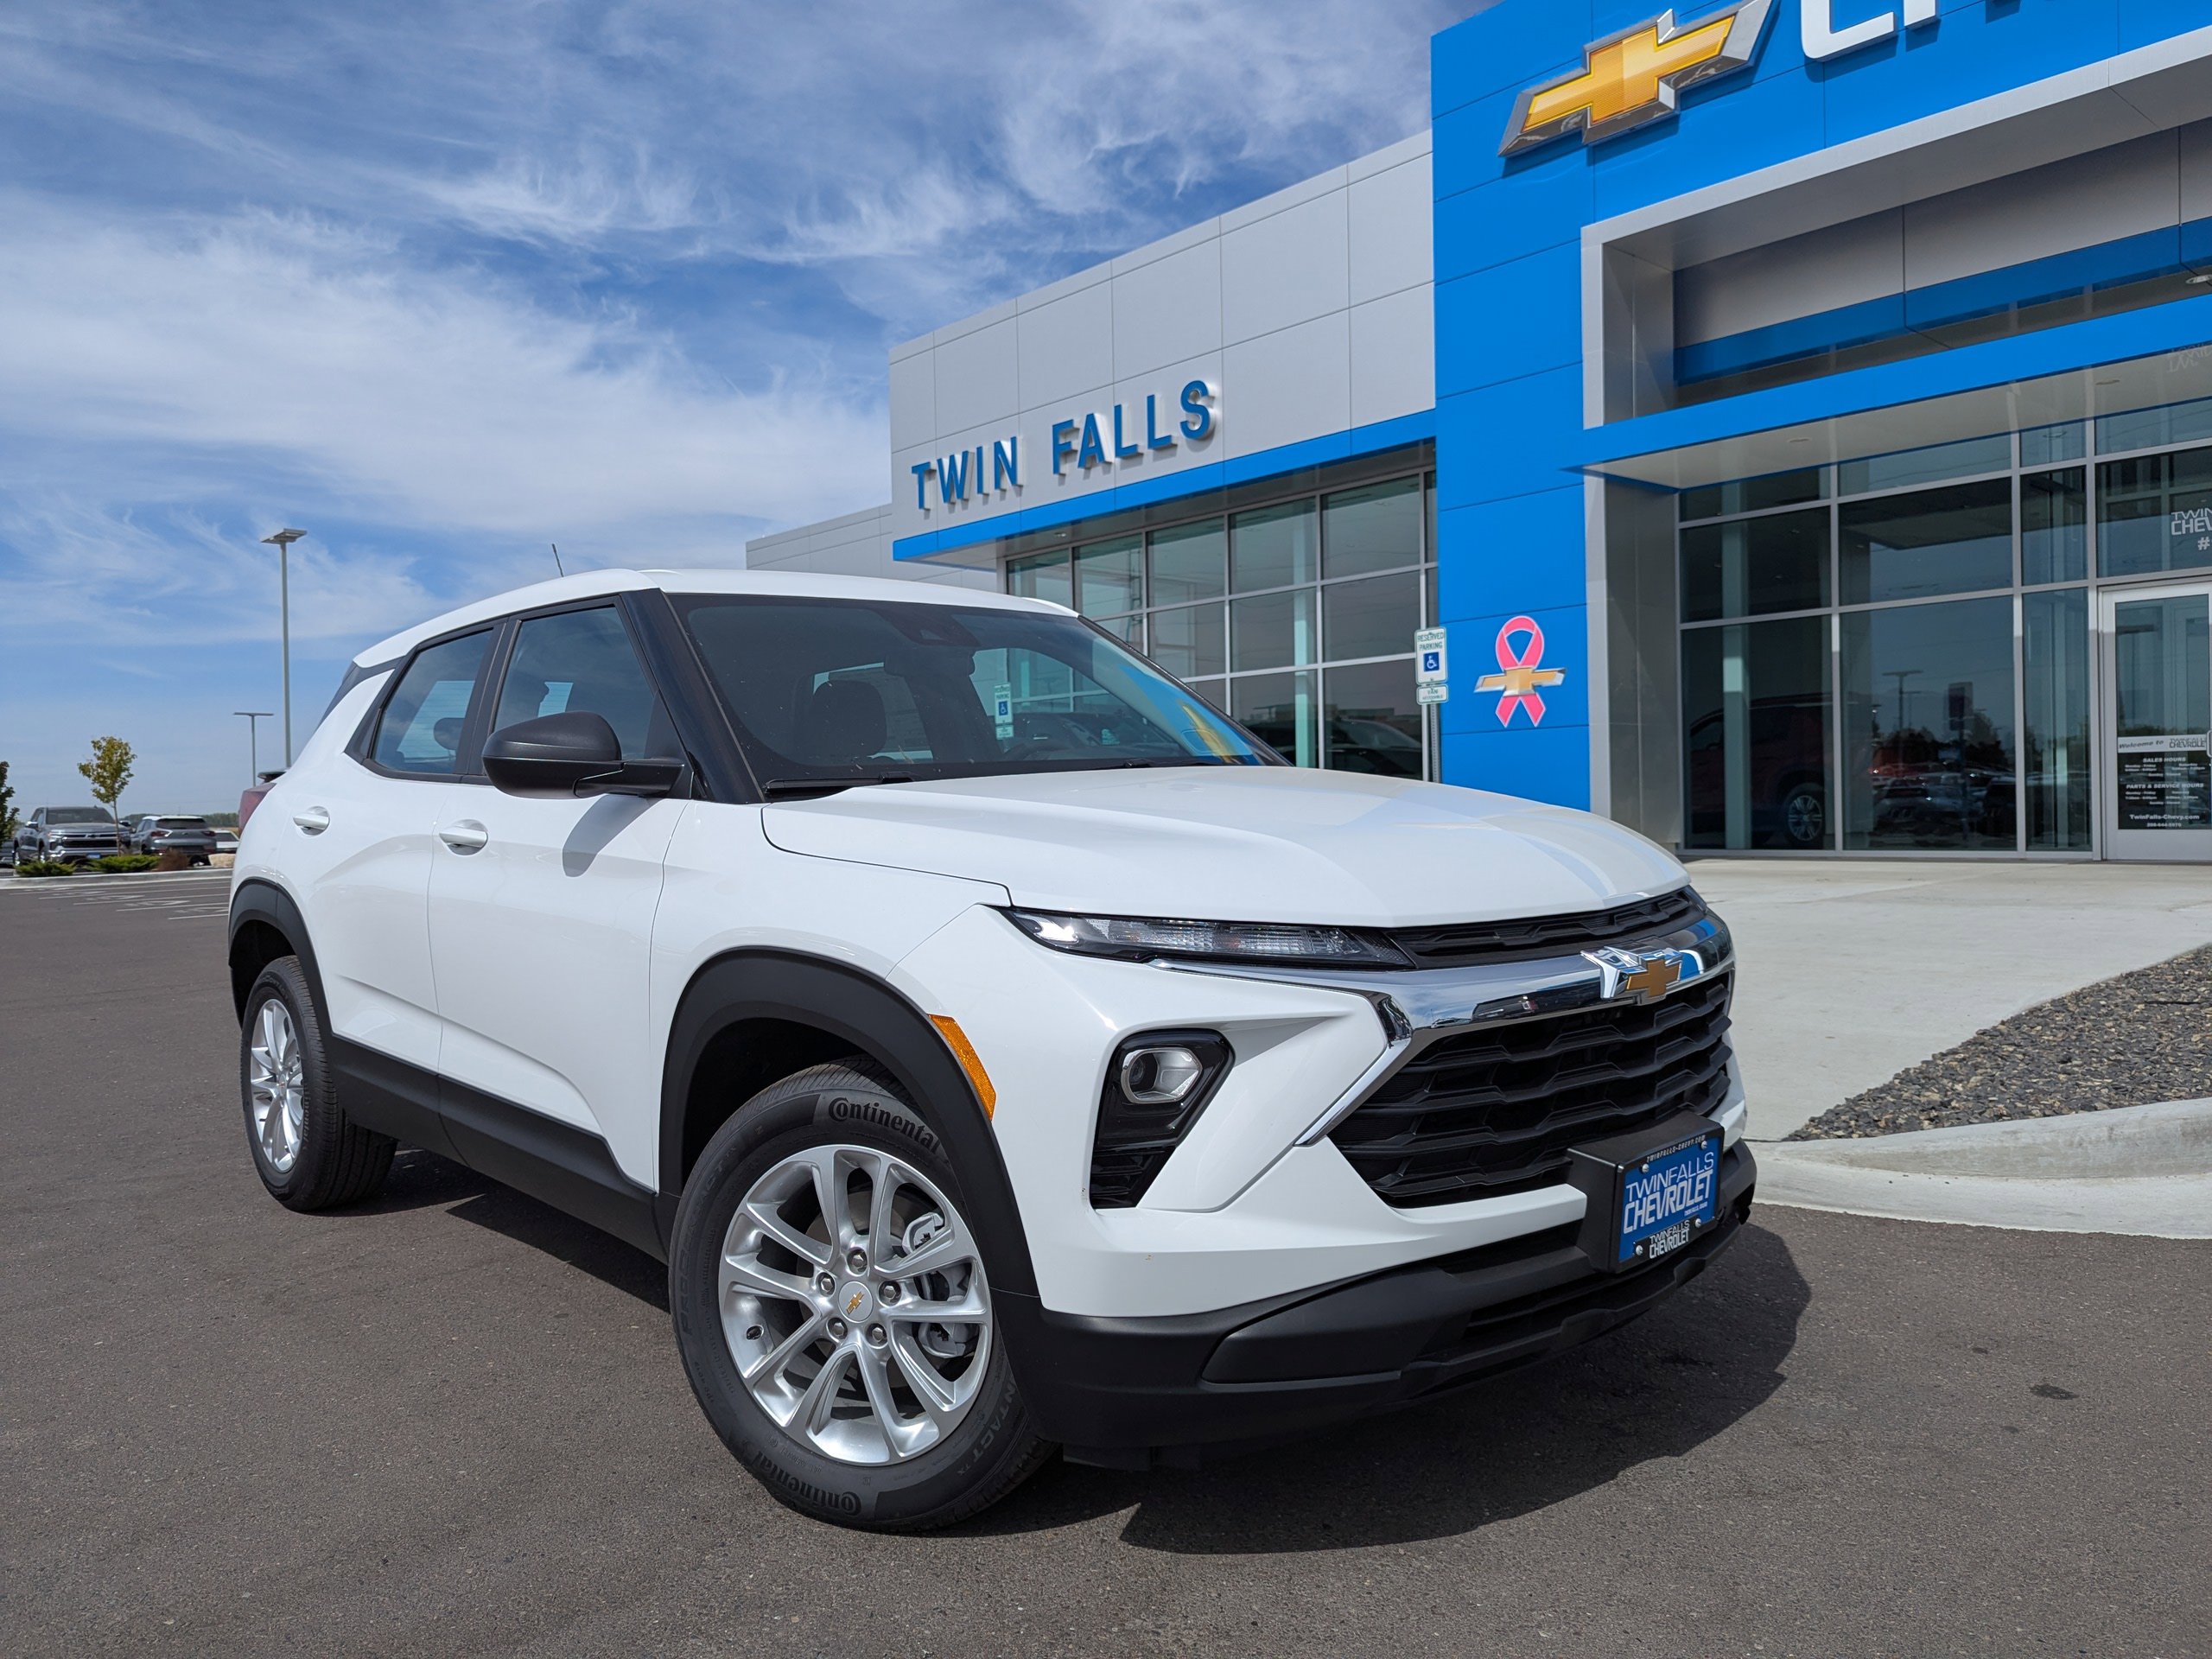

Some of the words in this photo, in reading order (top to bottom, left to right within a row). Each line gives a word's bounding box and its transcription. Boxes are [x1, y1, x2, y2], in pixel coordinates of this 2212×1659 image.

[912, 436, 1020, 510] TWIN
[1052, 380, 1212, 475] FALLS
[1417, 632, 1444, 642] RESERVED
[1419, 642, 1443, 651] PARKING
[828, 1096, 941, 1154] Continental
[1623, 1169, 1713, 1234] CHEVROLET
[1625, 1152, 1714, 1202] TWINFALLS
[1649, 1219, 1690, 1243] TWINFALLS
[1649, 1228, 1690, 1259] CHEVROLET
[750, 1451, 862, 1516] Continental
